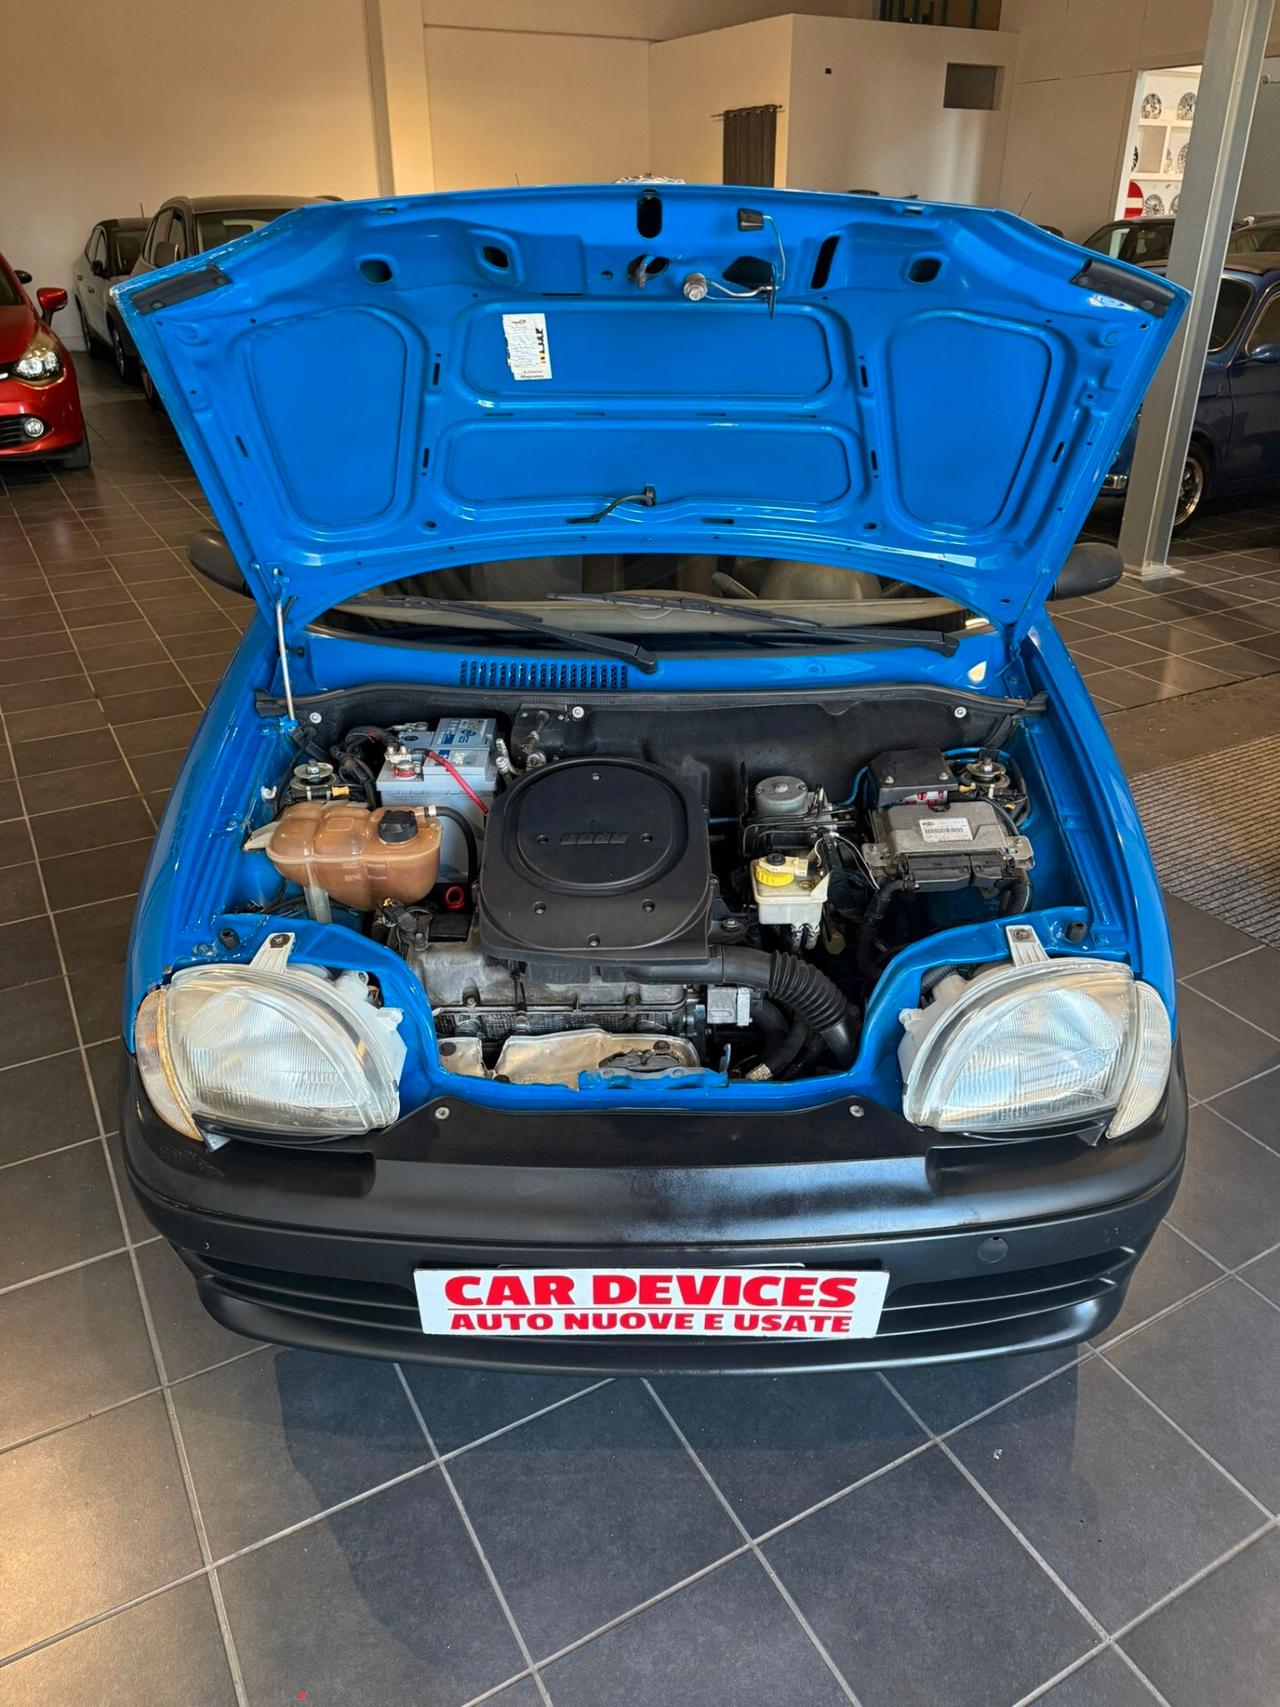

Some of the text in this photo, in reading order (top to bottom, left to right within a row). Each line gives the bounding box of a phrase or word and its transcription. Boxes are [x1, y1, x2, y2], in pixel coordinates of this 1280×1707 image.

[445, 1275, 857, 1307] CAR DEVICES
[450, 1312, 853, 1333] AUTO NUOVE E USATE
